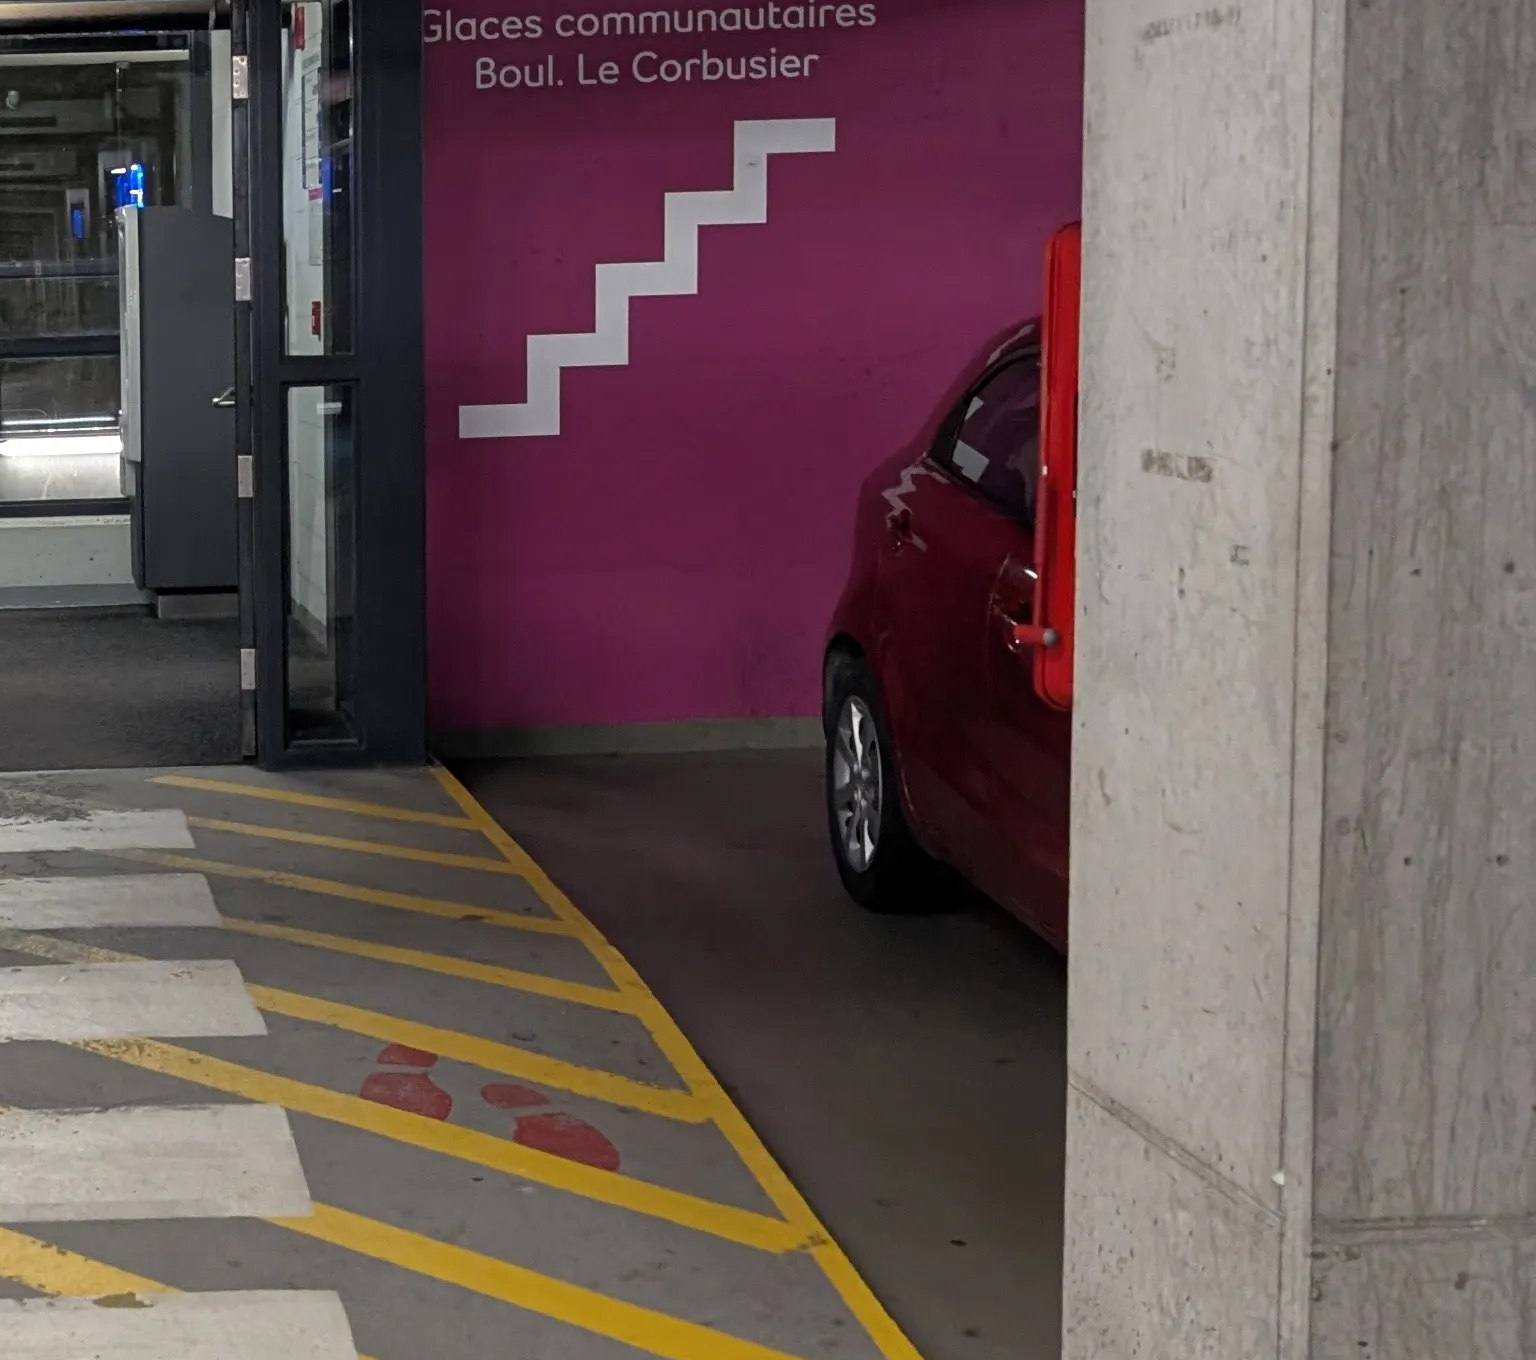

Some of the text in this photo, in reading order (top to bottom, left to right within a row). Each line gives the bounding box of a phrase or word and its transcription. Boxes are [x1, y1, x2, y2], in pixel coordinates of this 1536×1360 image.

[423, 8, 543, 43] Glaces
[475, 47, 819, 89] Boul. Le Corbusier
